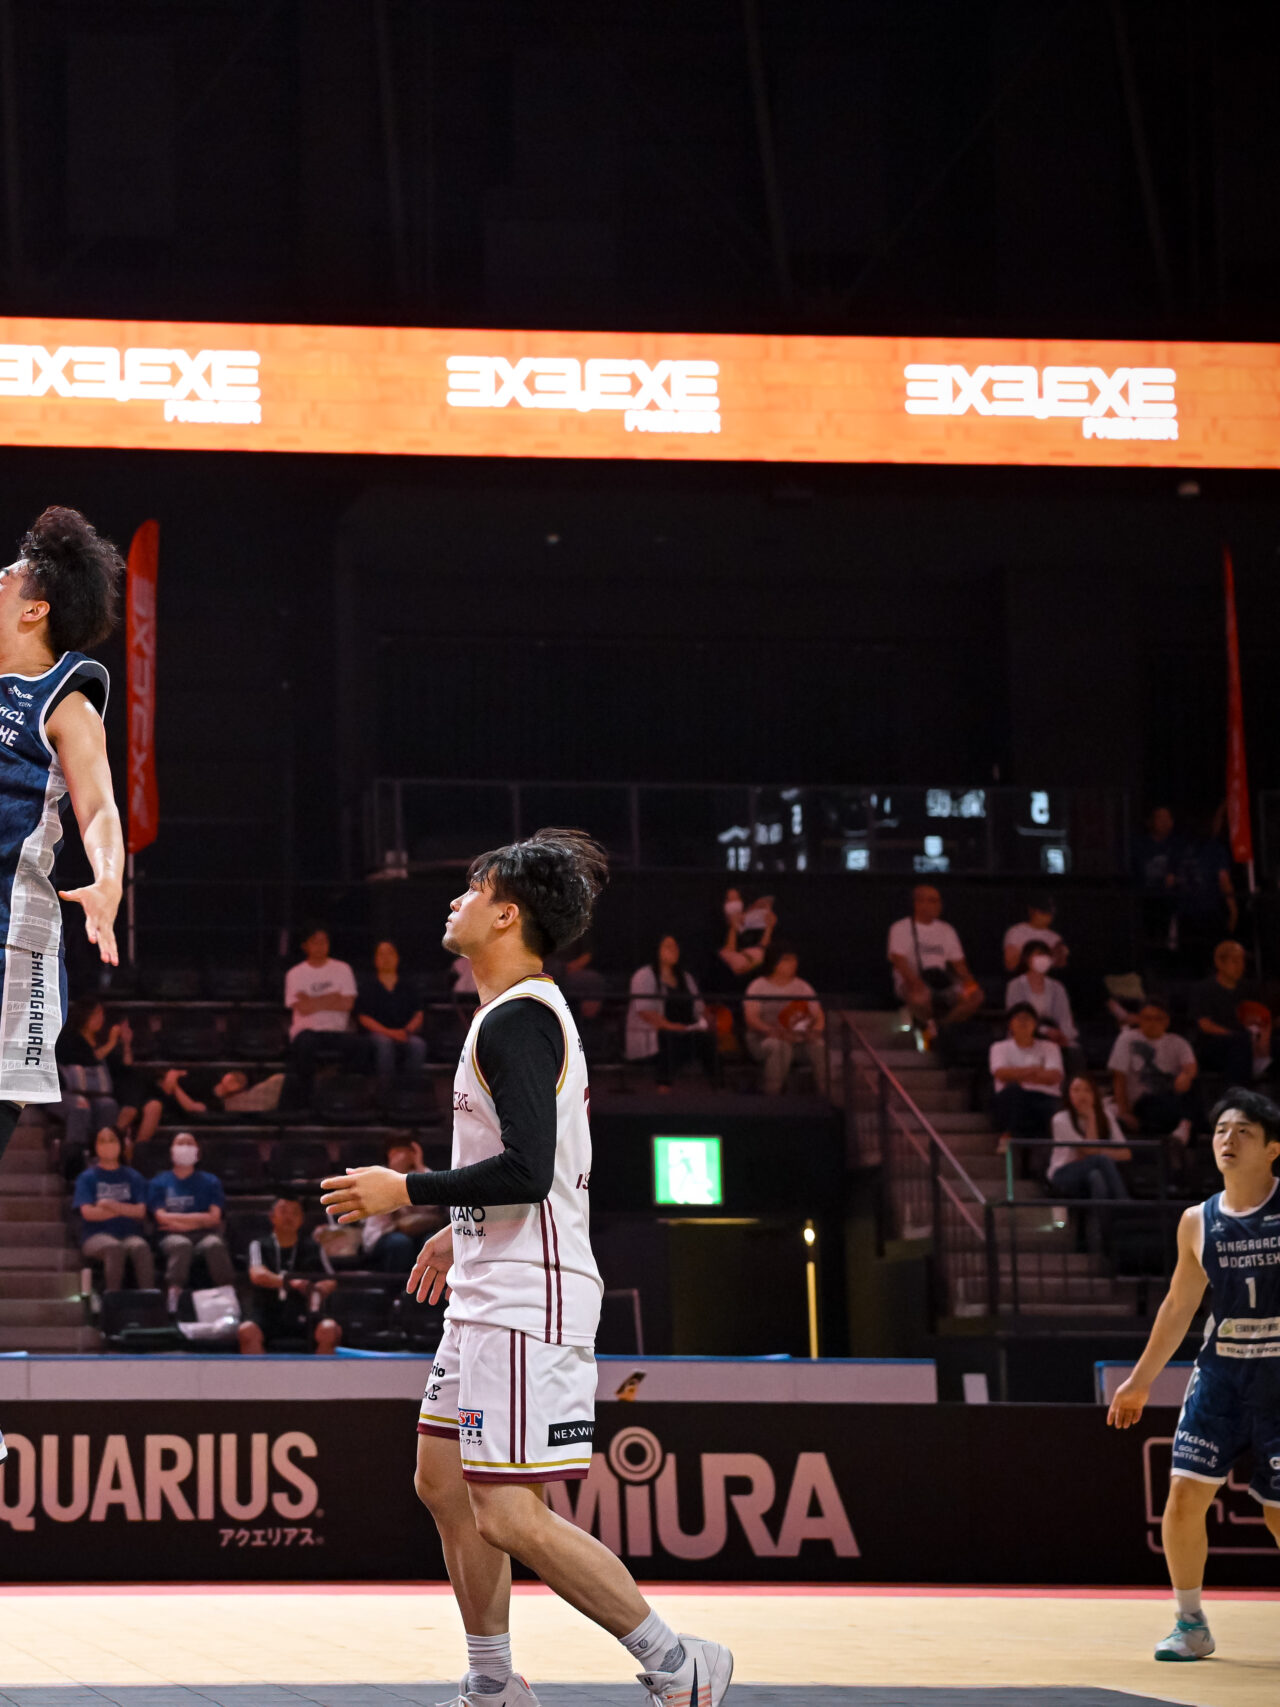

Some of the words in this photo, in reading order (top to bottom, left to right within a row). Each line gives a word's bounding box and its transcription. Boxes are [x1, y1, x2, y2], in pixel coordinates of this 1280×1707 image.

[25, 951, 45, 1066] SHINAGAWACC
[1245, 1277, 1256, 1308] 1
[219, 1527, 316, 1547] アクエリアス
